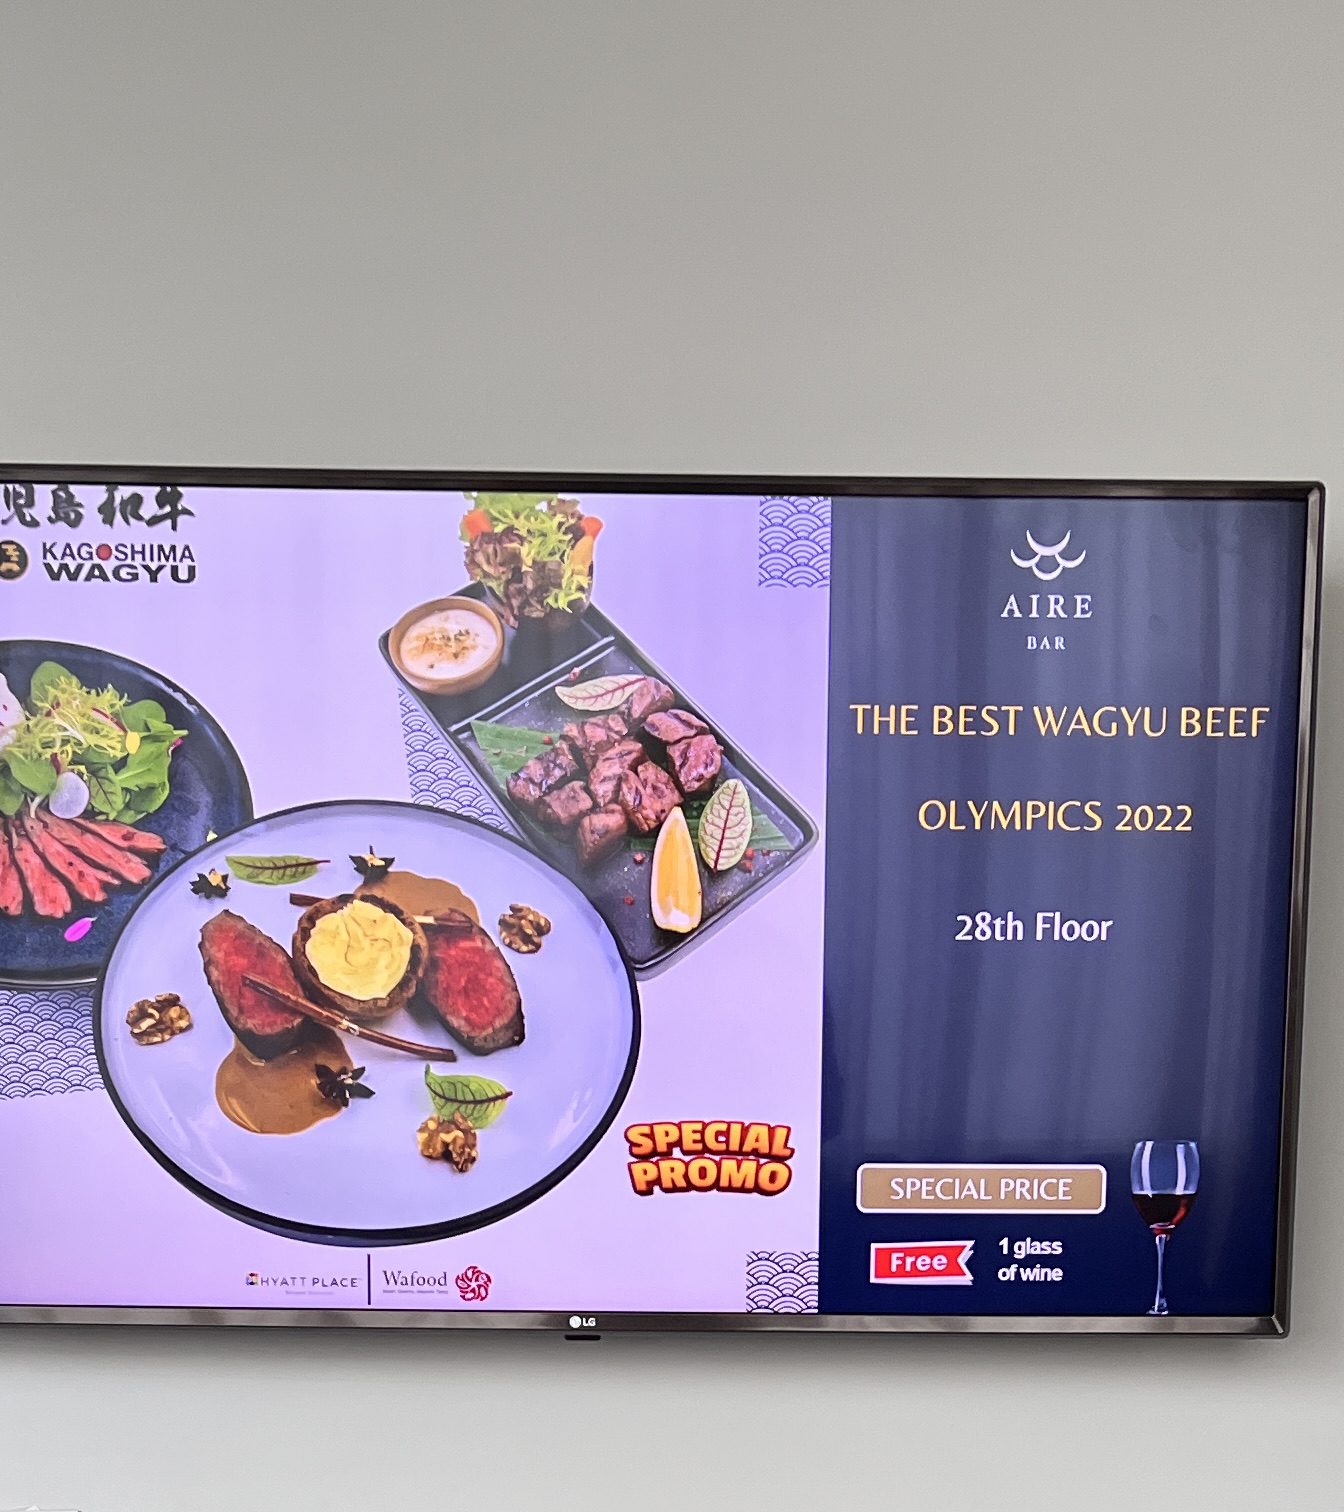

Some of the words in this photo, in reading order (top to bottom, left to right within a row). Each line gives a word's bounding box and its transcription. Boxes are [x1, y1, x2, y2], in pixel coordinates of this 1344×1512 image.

[42, 542, 195, 562] KAGOSHIMA
[43, 563, 197, 583] WAGYU
[1001, 594, 1094, 618] AIRE
[1027, 636, 1066, 650] BAR
[849, 704, 919, 735] THE
[933, 705, 1023, 736] BEST
[1033, 706, 1168, 738] WAGYU
[1180, 707, 1269, 738] BEEF
[918, 800, 1103, 831] OLYMPICS
[1115, 804, 1193, 831] 2022
[955, 912, 1024, 941] 28th
[1036, 912, 1113, 941] Floor
[626, 1121, 794, 1160] SPECIAL
[629, 1157, 792, 1194] PROMO
[890, 1178, 992, 1200] SPECIAL
[1000, 1178, 1072, 1200] PRICE
[999, 1238, 1008, 1254] 1
[1014, 1237, 1062, 1259] glass
[890, 1252, 947, 1272] Free
[998, 1264, 1017, 1281] of
[1020, 1265, 1063, 1281] wine
[260, 1277, 307, 1288] HYATT
[312, 1277, 358, 1288] PLACE
[383, 1269, 448, 1287] Wafood
